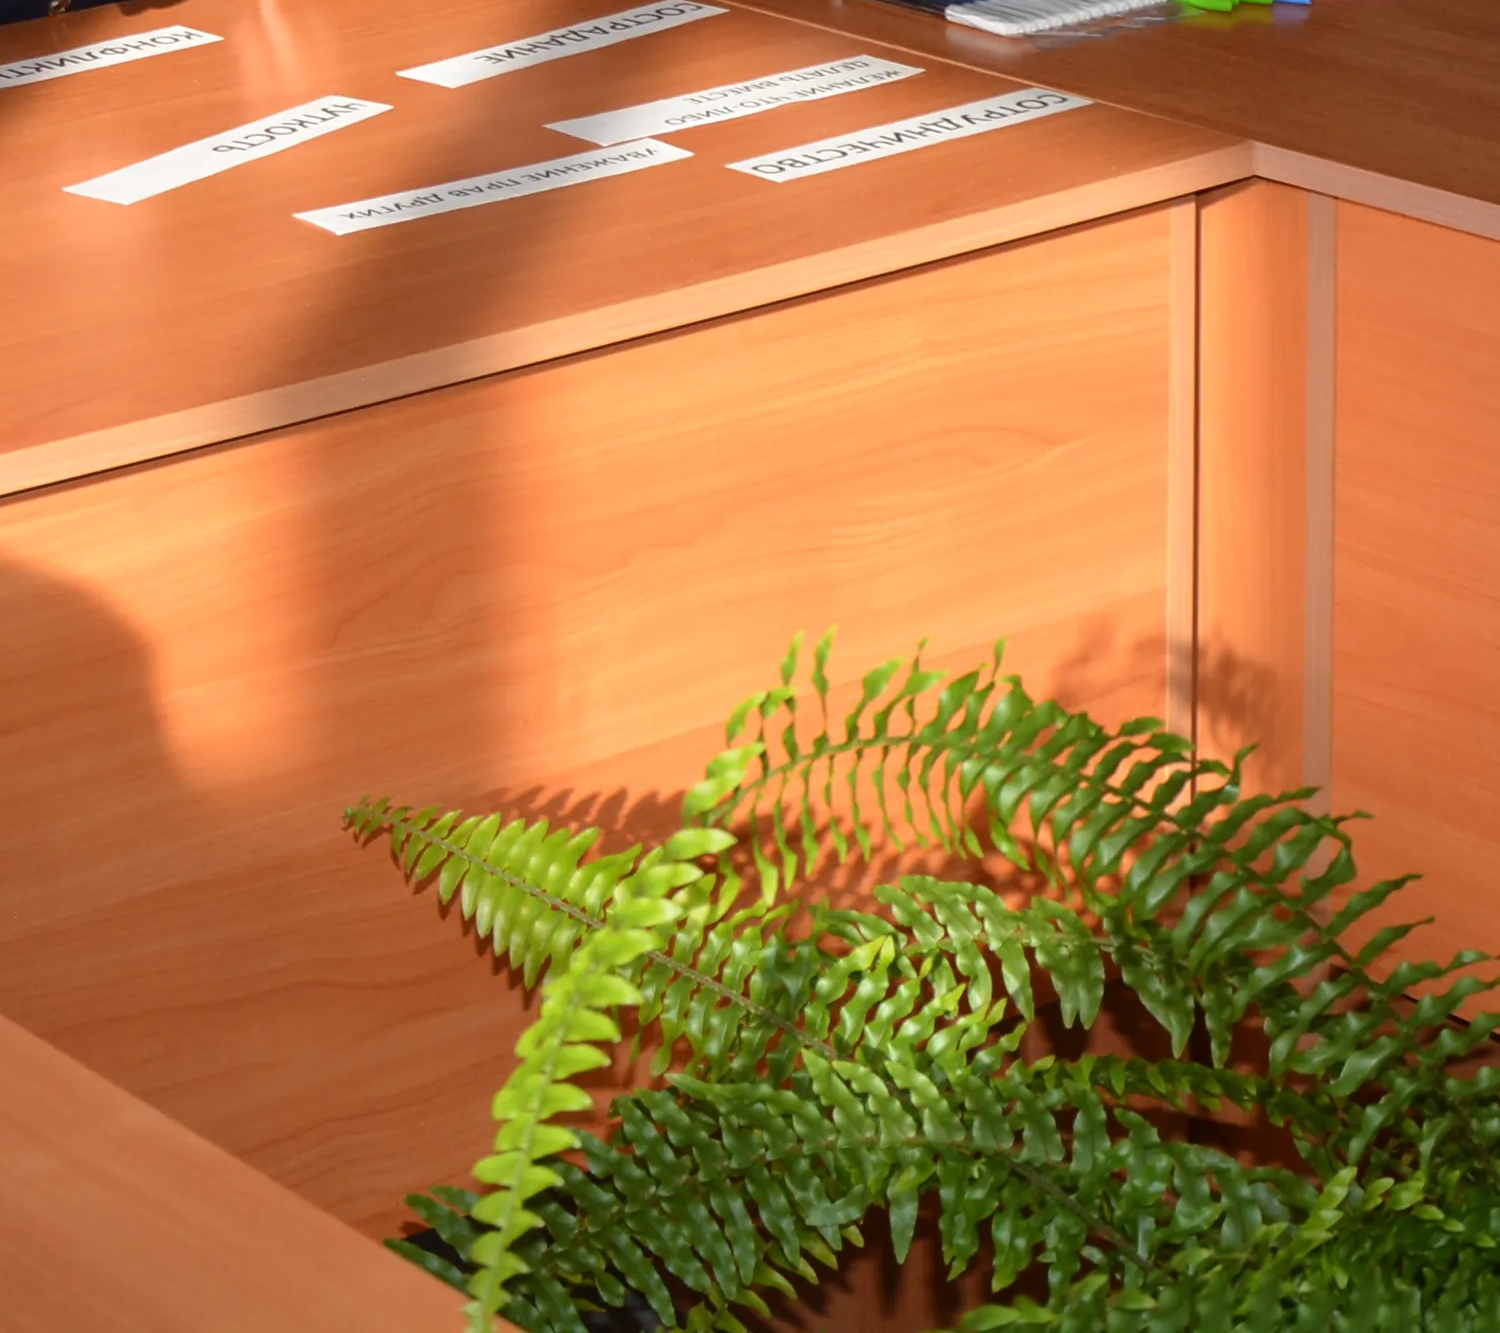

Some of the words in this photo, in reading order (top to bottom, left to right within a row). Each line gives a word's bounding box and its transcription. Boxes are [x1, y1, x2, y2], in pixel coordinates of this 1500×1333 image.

[680, 74, 774, 106] ВМЕСТЕ
[775, 57, 872, 85] ДЕЛАТЬ
[791, 66, 905, 106] ЖЕЛАНИЕ
[211, 99, 367, 156] ЧУТКОСТЬ
[661, 88, 790, 128] ЧТО-ЛИБО
[749, 90, 1071, 179] СОТРУДНИЧЕСТВО
[523, 142, 661, 185] УВАЖЕНИЕ
[338, 191, 445, 224] ДРУГИХ
[447, 175, 522, 203] ПРАВ
